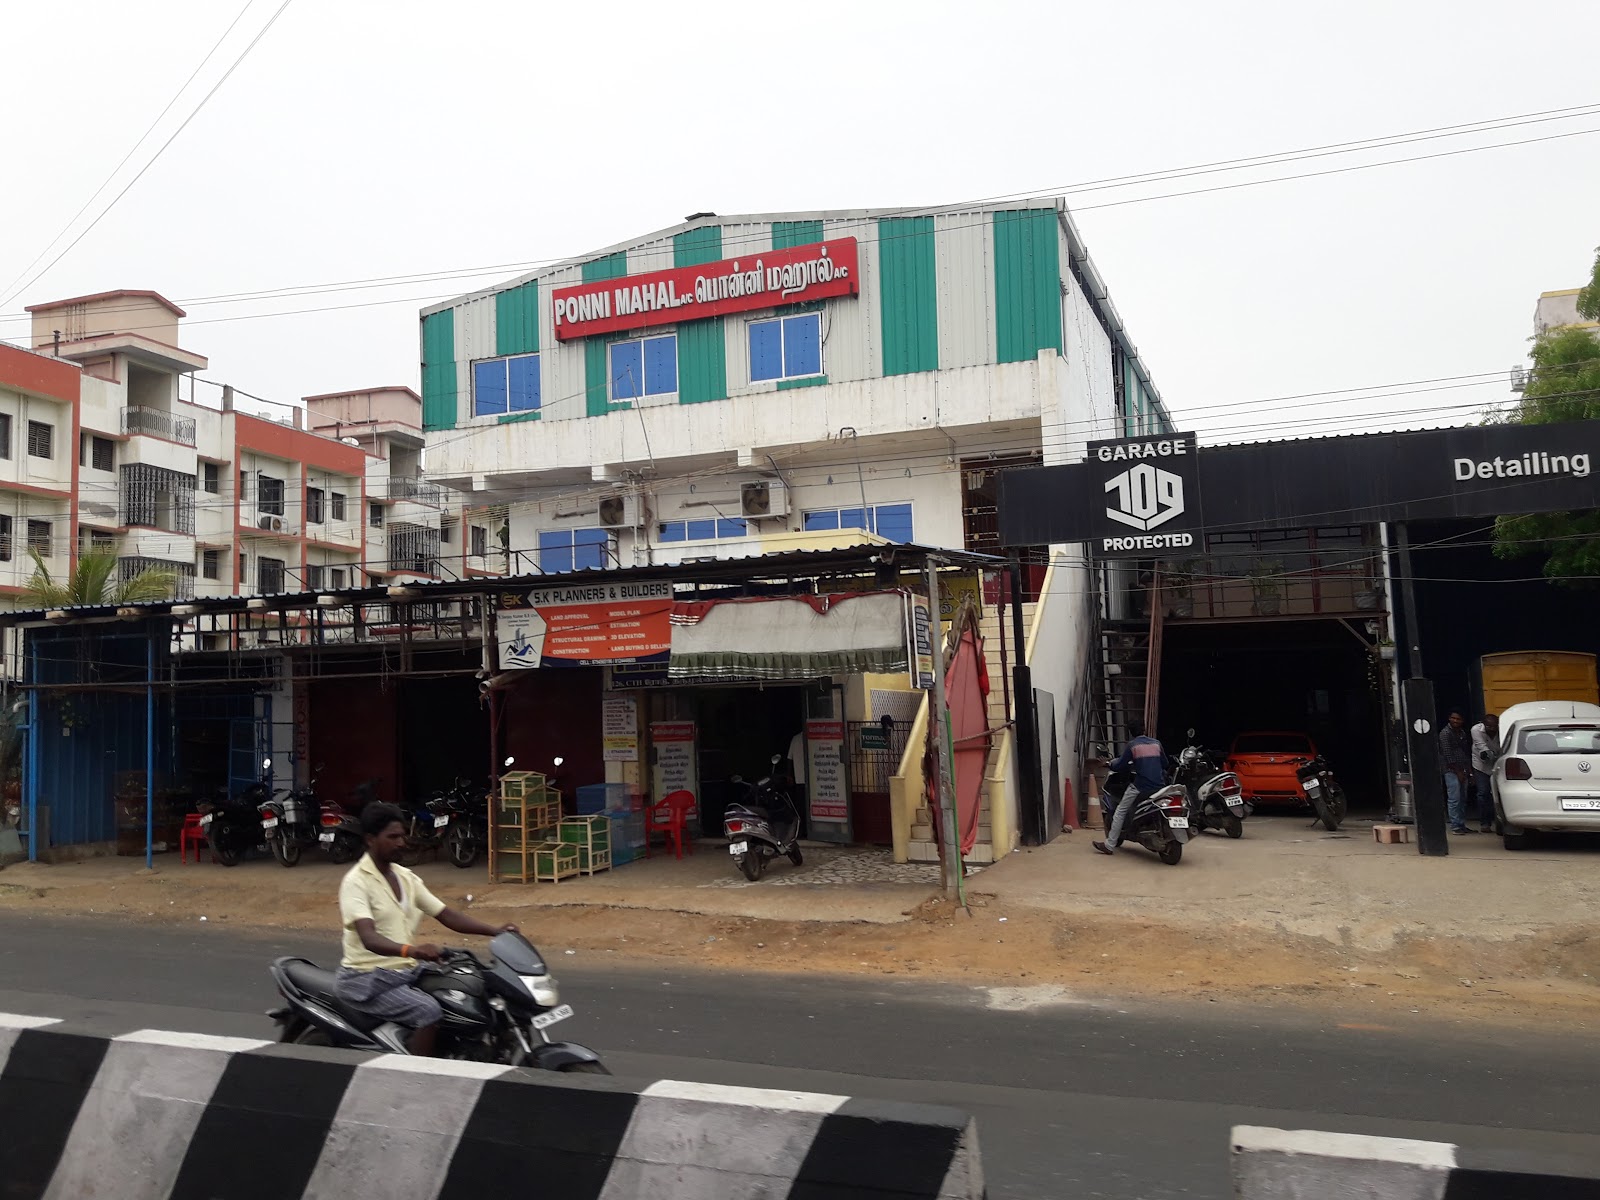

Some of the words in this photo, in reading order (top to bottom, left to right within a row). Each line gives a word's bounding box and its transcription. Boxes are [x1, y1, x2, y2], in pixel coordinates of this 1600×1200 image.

[555, 290, 612, 326] PONNI
[615, 280, 681, 316] MAHAL
[694, 259, 764, 303] பொன்னி
[1097, 439, 1187, 462] GARAGE
[1453, 451, 1591, 481] Detailing
[1103, 533, 1193, 552] PROTECTED
[502, 592, 523, 606] SK
[534, 591, 549, 604] S.K
[553, 587, 605, 603] PLANNERS
[609, 586, 617, 598] &
[621, 582, 669, 598] BUILDERS
[564, 612, 590, 620] APPROVAL
[617, 632, 646, 640] ELEVATION
[552, 647, 590, 655] CONSTRUCTION
